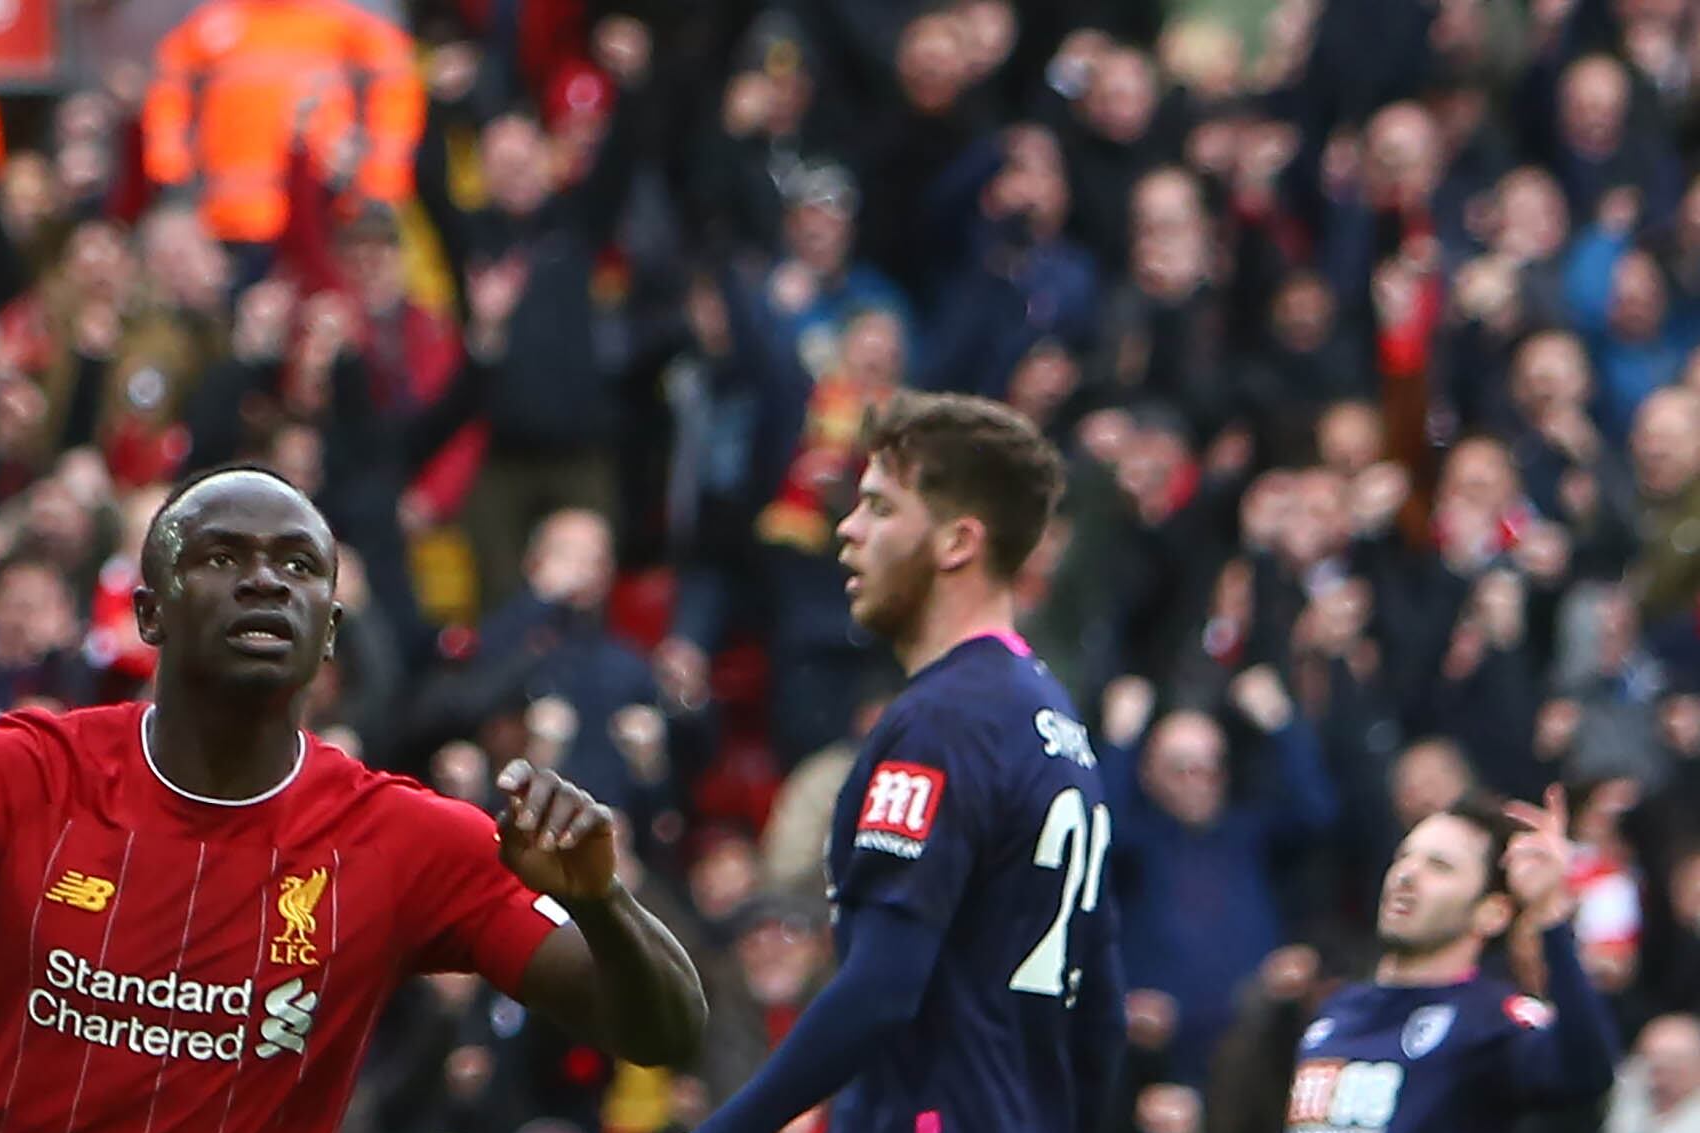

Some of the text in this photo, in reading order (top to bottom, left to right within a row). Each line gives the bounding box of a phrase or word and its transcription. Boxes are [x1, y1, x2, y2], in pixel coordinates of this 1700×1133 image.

[45, 948, 252, 1017] Standard
[269, 942, 320, 967] LFC
[28, 987, 245, 1062] Chartered
